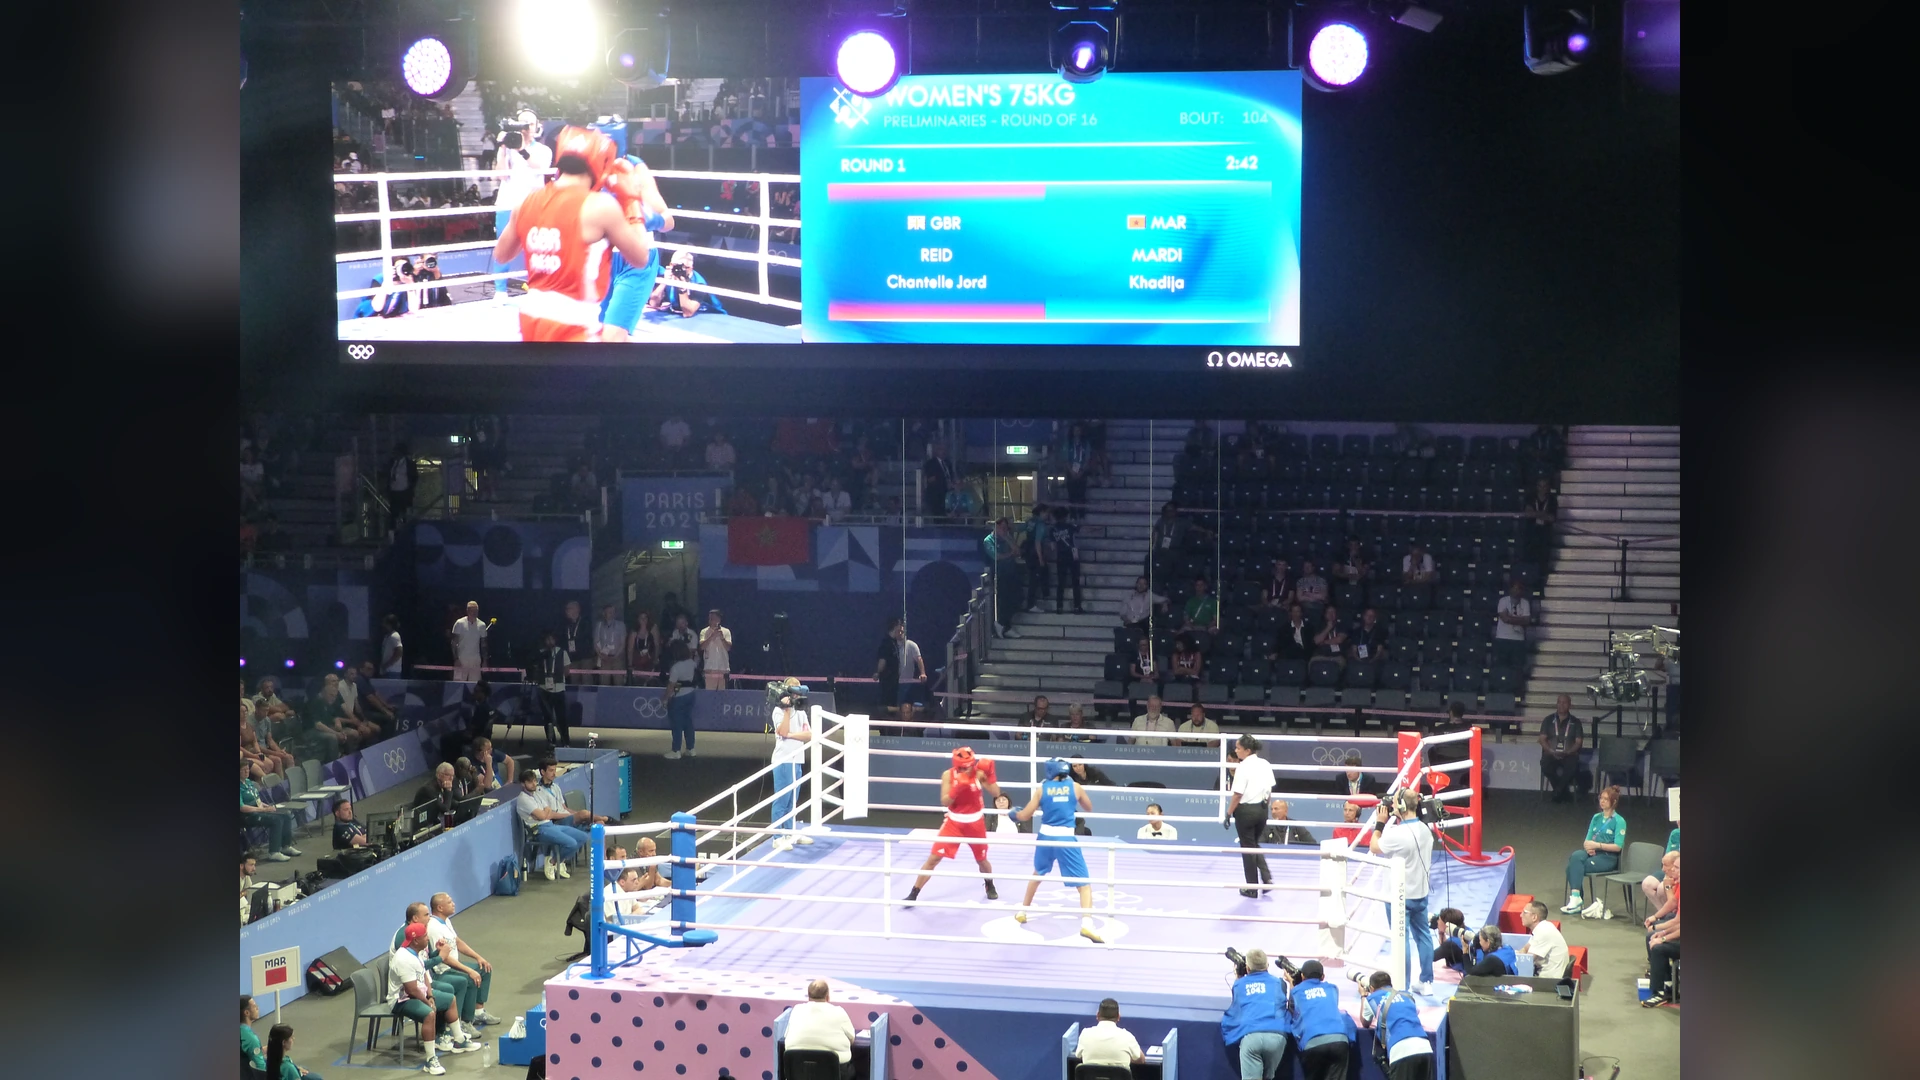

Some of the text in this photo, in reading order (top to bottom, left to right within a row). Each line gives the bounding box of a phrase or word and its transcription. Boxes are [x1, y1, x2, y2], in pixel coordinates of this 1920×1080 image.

[887, 83, 1076, 107] WOMEN'S 75KG
[884, 114, 987, 128] PRELIMINARIES
[1001, 113, 1053, 127] ROUND
[1056, 113, 1077, 126] OF
[1080, 113, 1098, 126] 16
[1180, 111, 1269, 125] BOUT: 104
[841, 158, 906, 172] ROUND 1
[1226, 155, 1258, 170] 2:42
[930, 215, 962, 231] GBR
[1150, 215, 1187, 230] MAR
[920, 247, 953, 263] REID
[1132, 248, 1183, 263] MARDI
[886, 274, 987, 290] Chantelle Jord
[1129, 274, 1185, 293] Khadija
[1226, 351, 1293, 368] OMEGA
[1482, 759, 1531, 773] 2024
[1047, 786, 1070, 796] MAR
[265, 957, 287, 969] MAR
